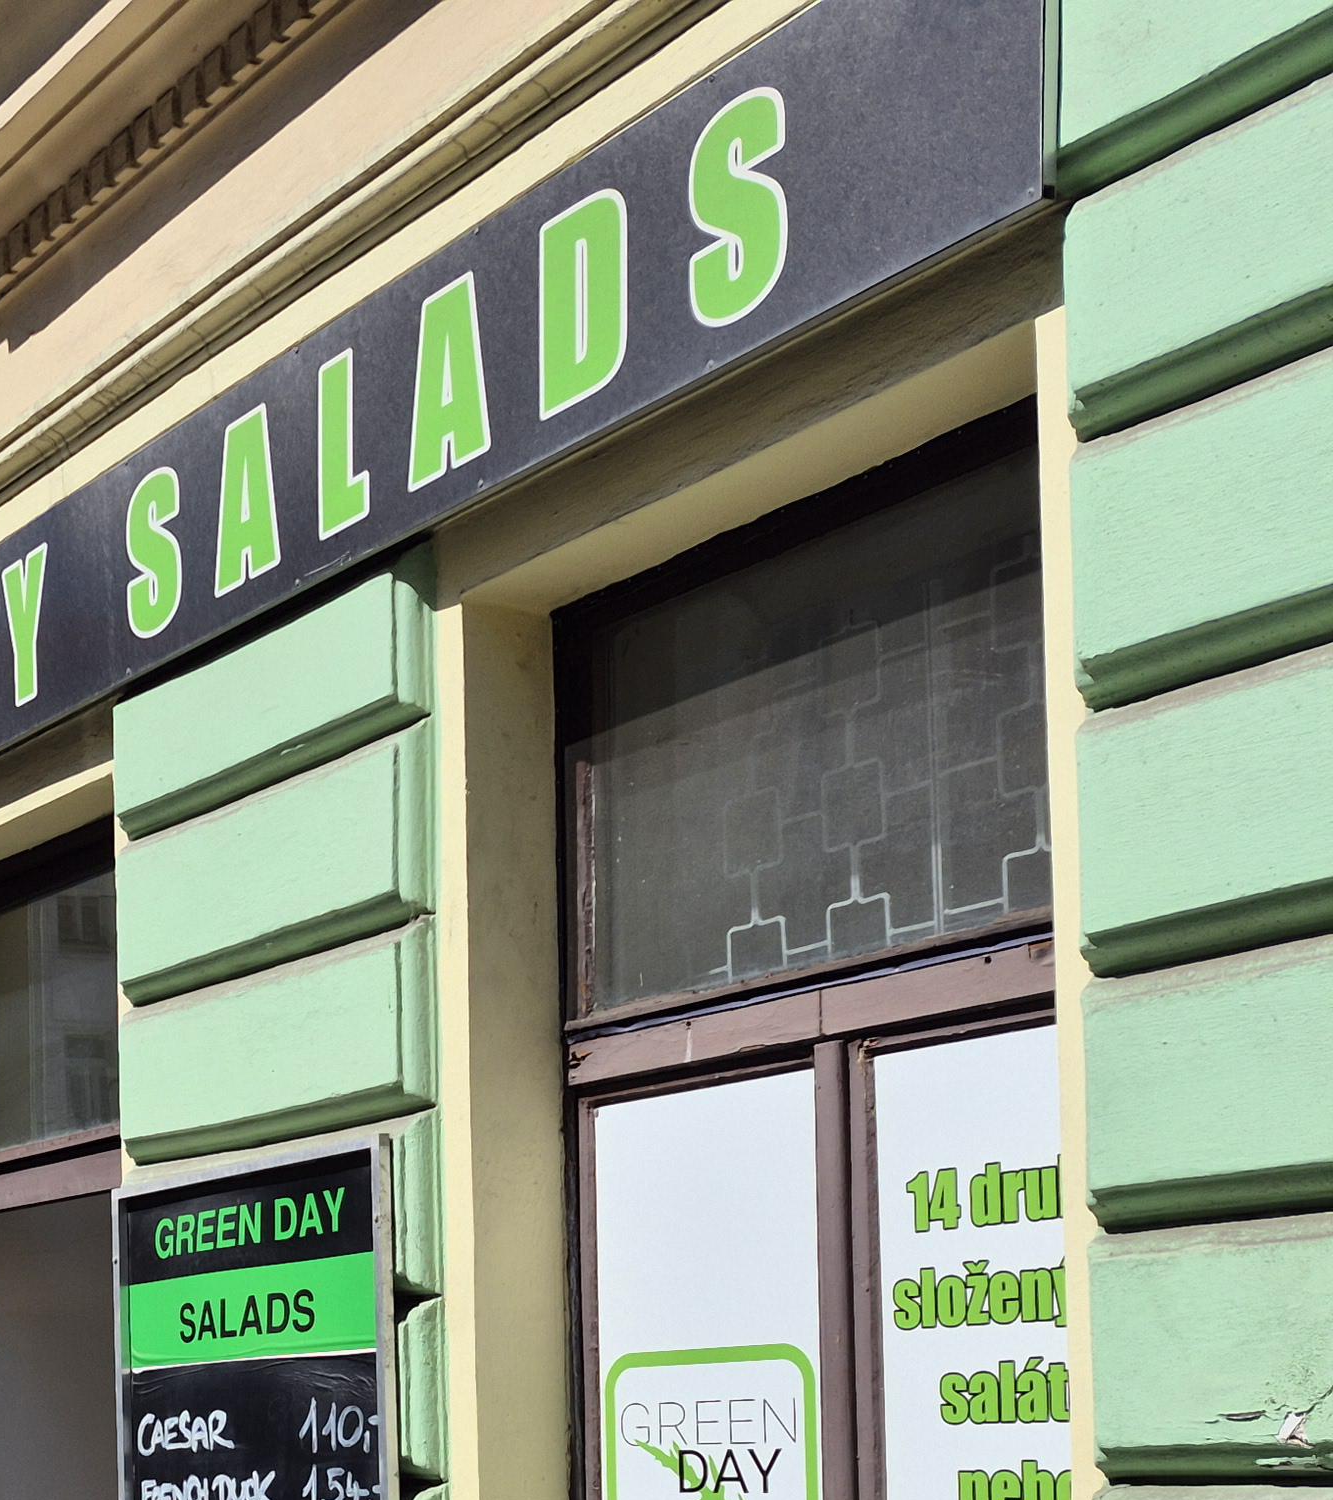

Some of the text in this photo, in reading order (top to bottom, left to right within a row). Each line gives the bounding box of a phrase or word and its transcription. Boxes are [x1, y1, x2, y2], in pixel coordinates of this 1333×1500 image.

[125, 84, 789, 640] SALADS
[906, 1154, 1064, 1233] 14 dru
[154, 1187, 345, 1260] GREEN DAY
[178, 1288, 316, 1346] SALADS
[137, 1409, 235, 1456] CAESAR
[620, 1397, 797, 1447] GREEN
[677, 1448, 782, 1494] DAY
